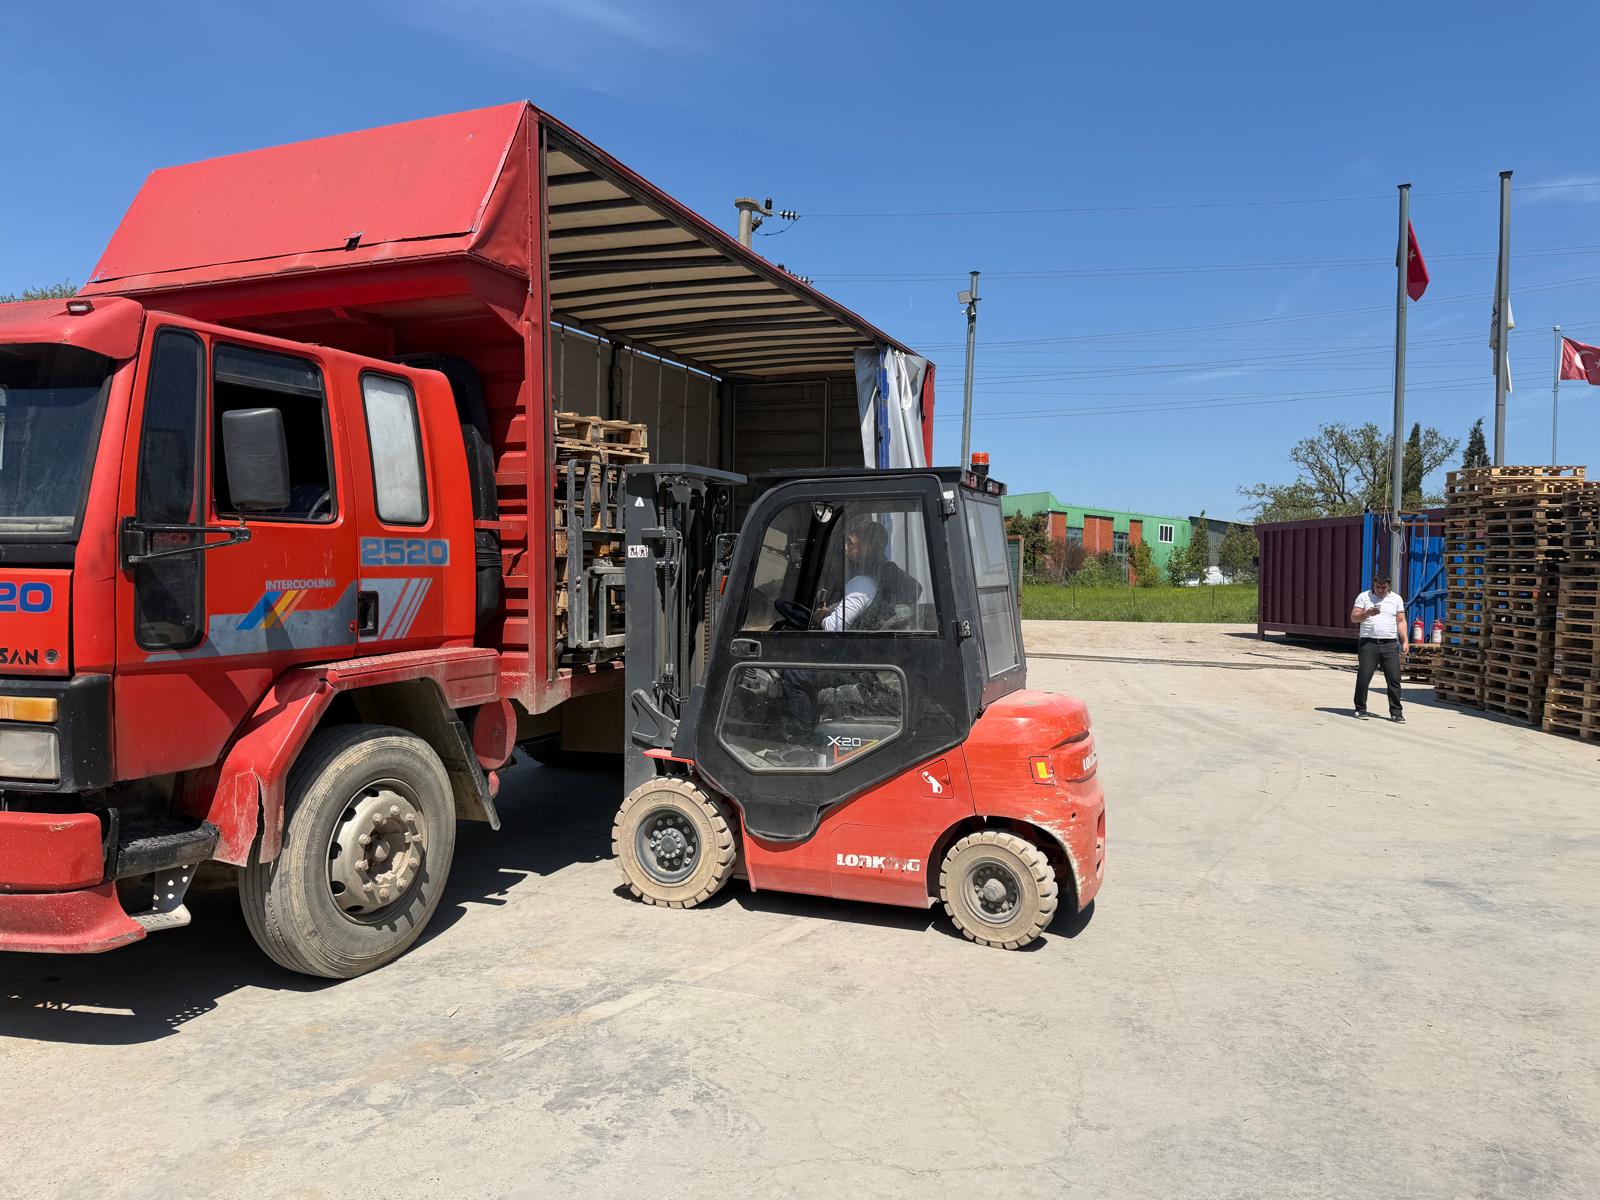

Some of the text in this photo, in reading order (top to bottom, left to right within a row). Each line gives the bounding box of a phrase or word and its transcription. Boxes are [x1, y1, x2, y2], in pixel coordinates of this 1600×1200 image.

[360, 537, 450, 566] 2520
[265, 578, 336, 591] INTERCOOLING
[0, 582, 53, 613] 20
[826, 735, 862, 747] X-20
